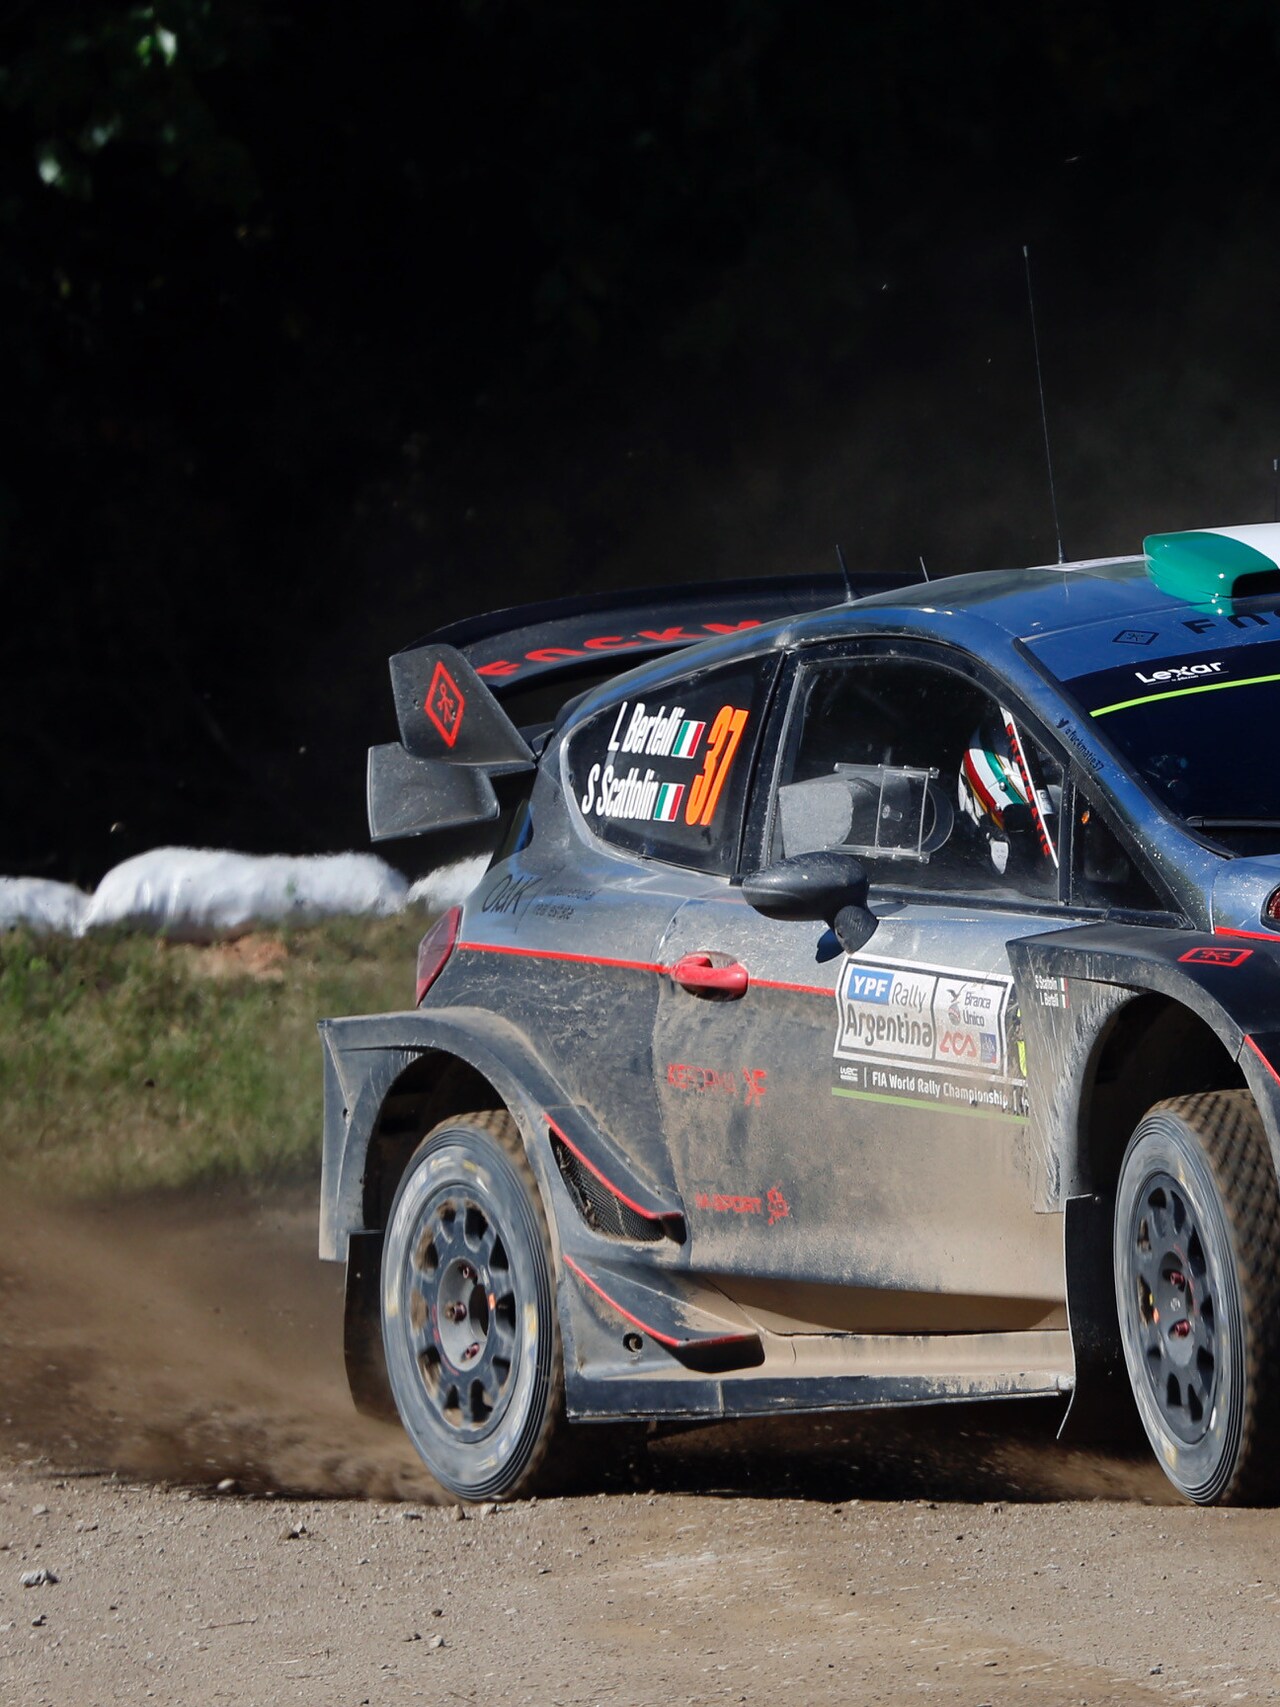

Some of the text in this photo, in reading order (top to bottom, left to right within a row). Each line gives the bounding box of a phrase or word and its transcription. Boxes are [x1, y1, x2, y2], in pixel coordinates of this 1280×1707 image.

[1135, 661, 1223, 684] Lexar
[607, 701, 686, 757] L Bertelli
[685, 704, 749, 826] 37
[581, 763, 660, 821] S Scattolin
[852, 975, 927, 1013] YPF Rally
[964, 991, 992, 1010] Branca
[845, 1003, 933, 1047] Argentina
[872, 1071, 888, 1089] FIA
[888, 1074, 916, 1091] World
[917, 1079, 941, 1099] Rally
[943, 1082, 1010, 1109] Championship
